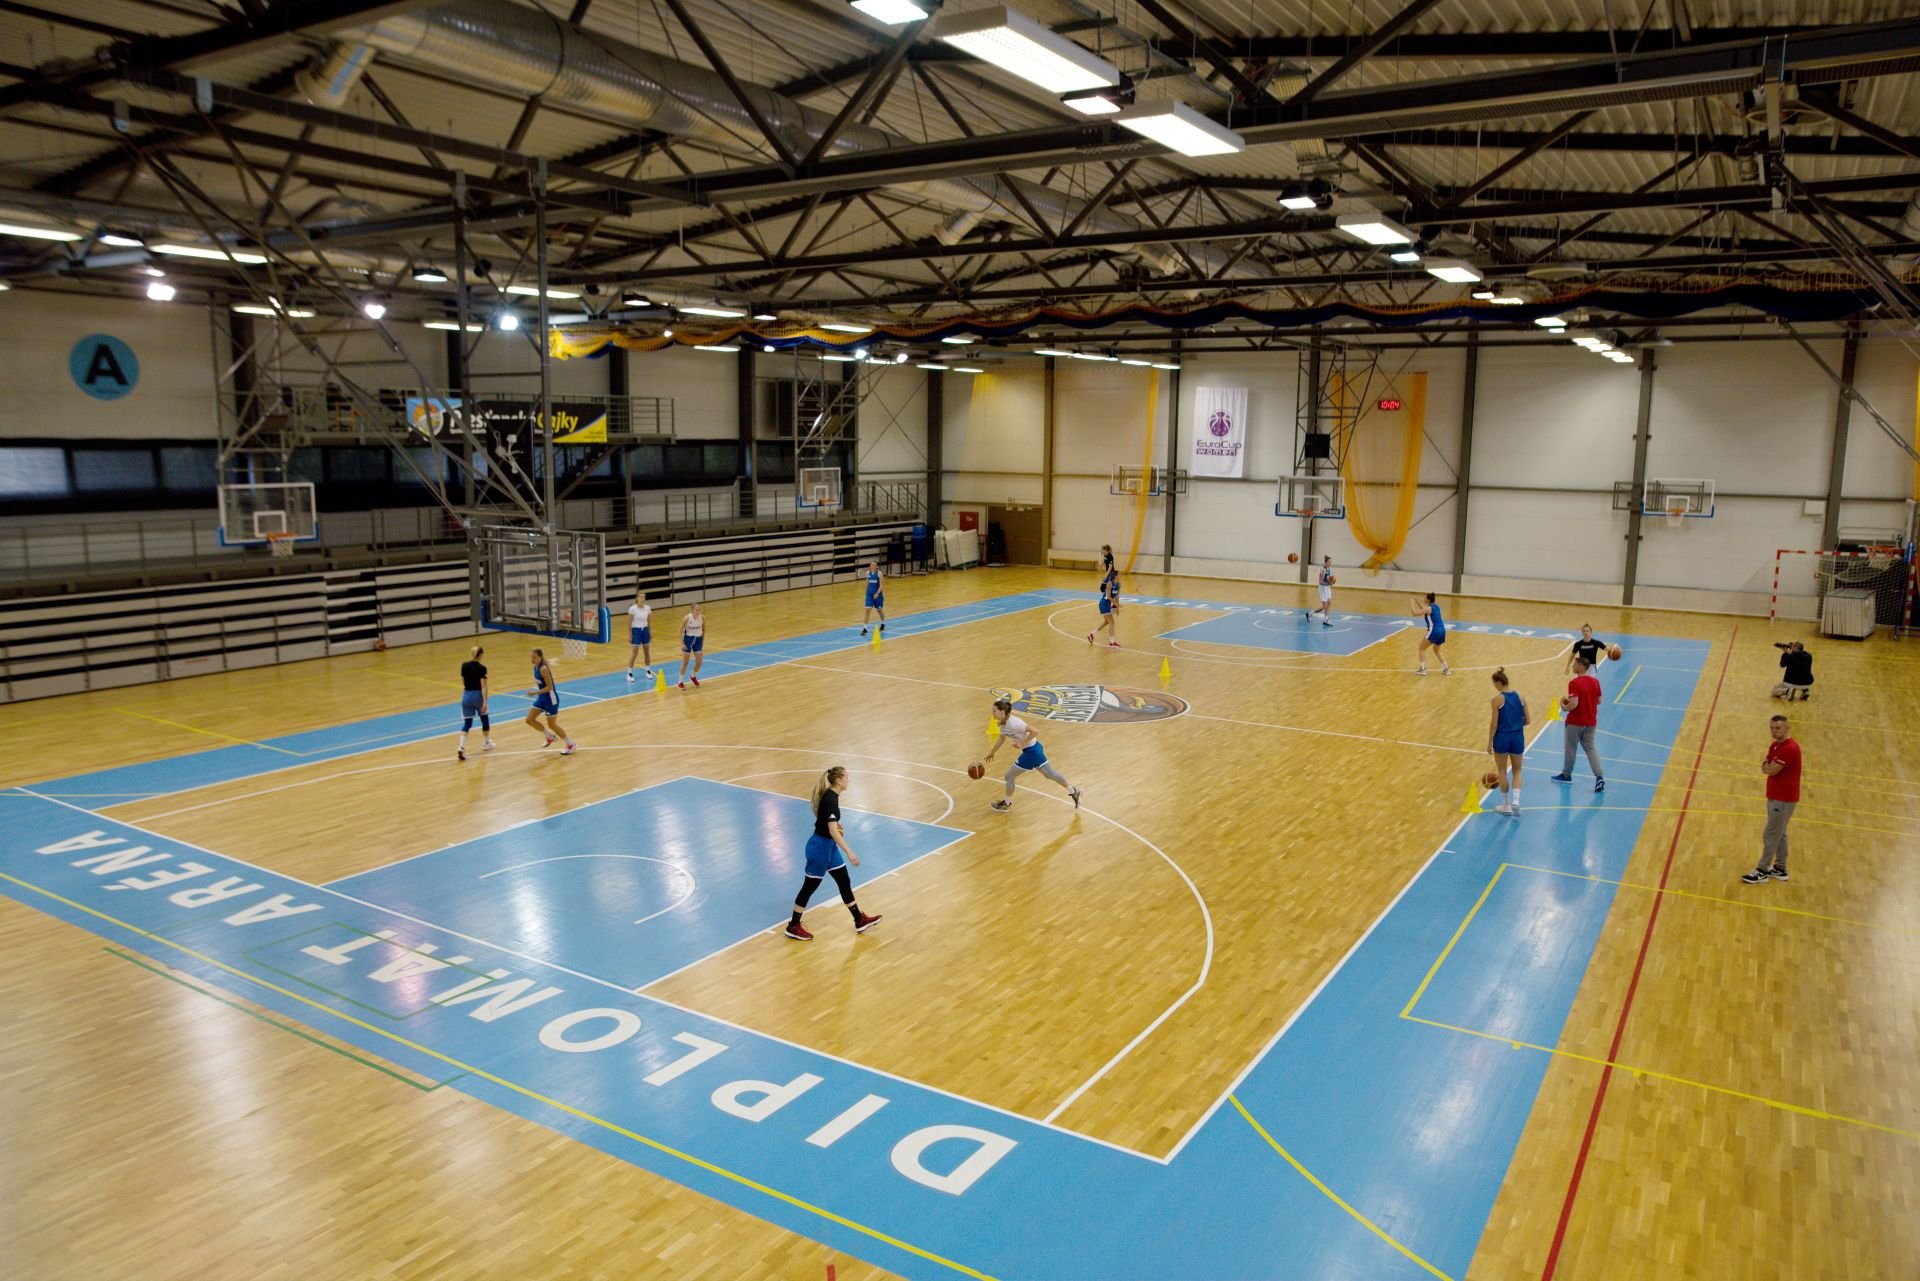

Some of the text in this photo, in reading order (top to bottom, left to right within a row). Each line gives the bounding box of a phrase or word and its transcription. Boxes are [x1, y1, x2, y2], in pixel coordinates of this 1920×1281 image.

[84, 344, 128, 386] A
[1381, 400, 1400, 409] 10:04
[1197, 439, 1242, 449] EuroCup
[35, 829, 1019, 1196] DIPLOMAT ARÉNA
